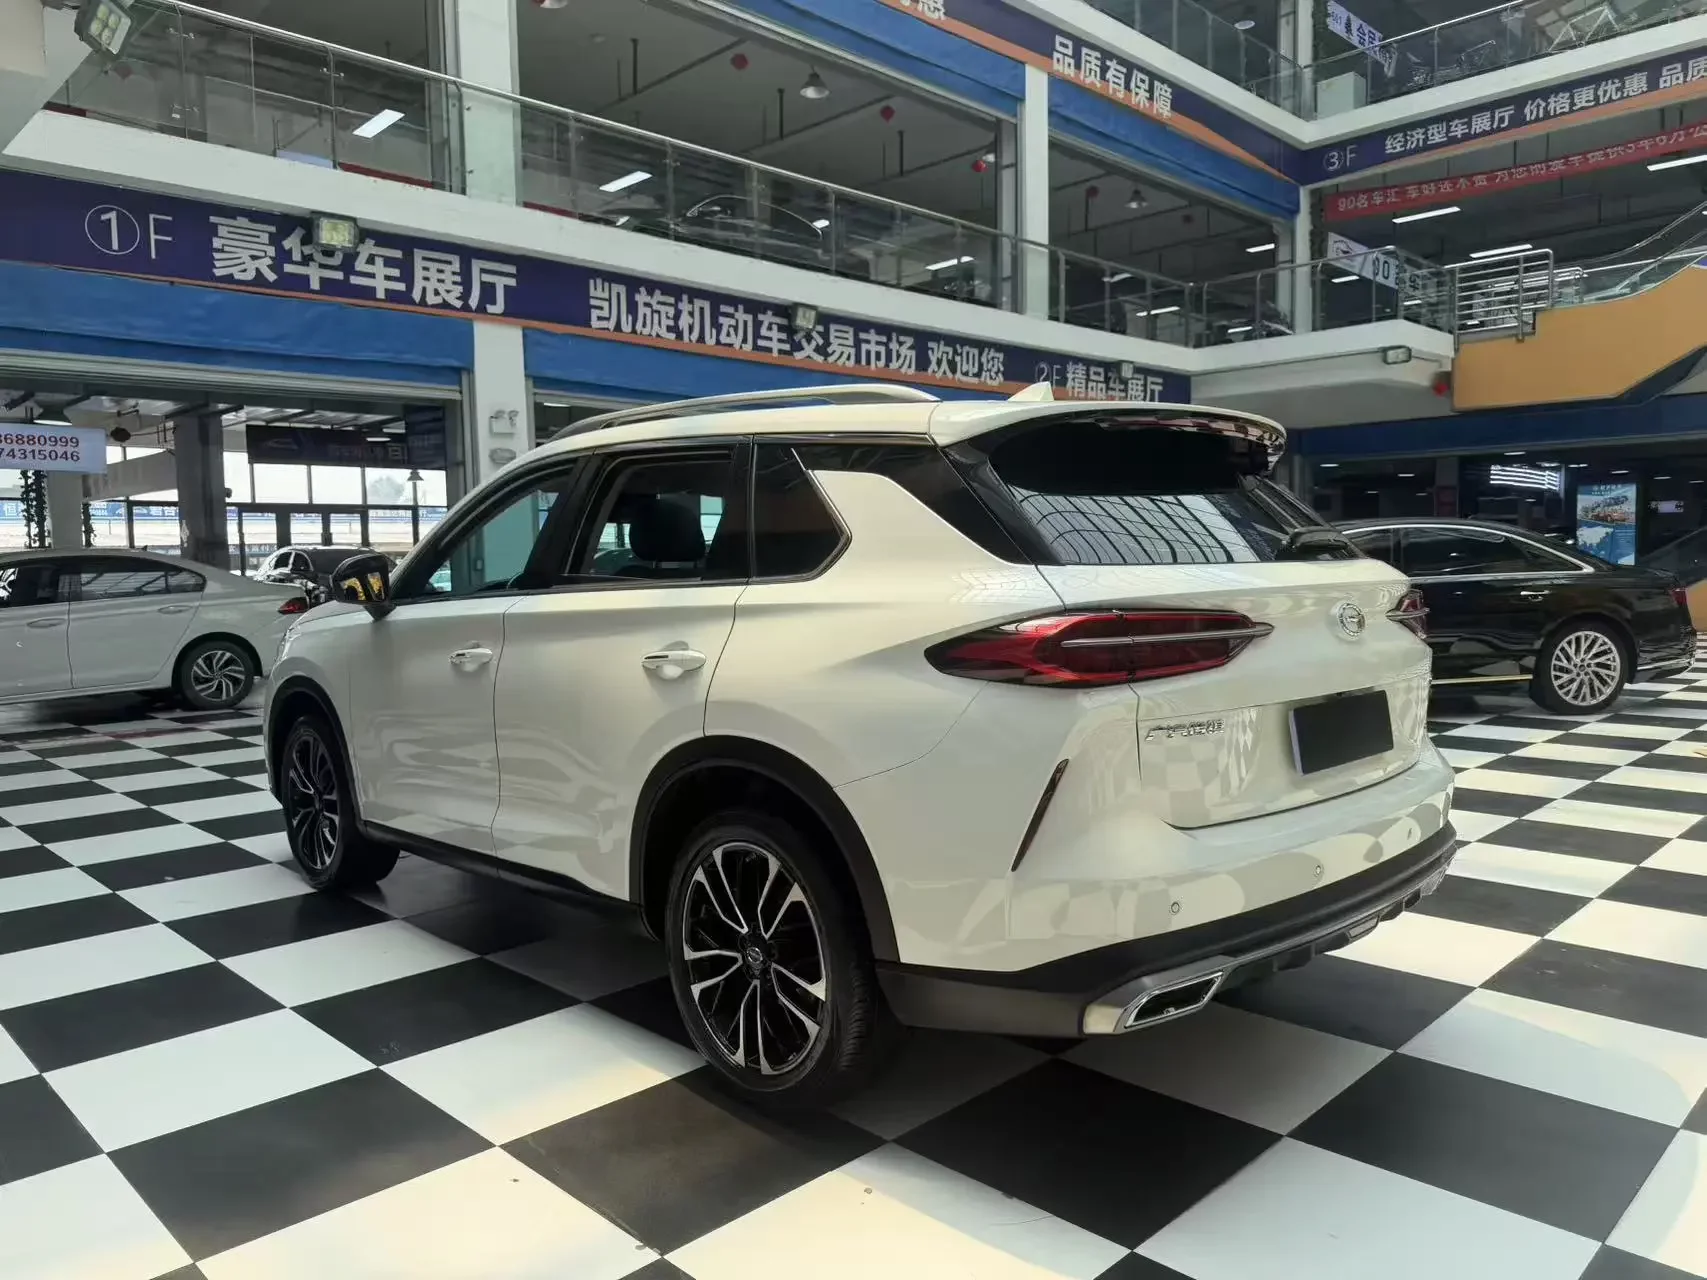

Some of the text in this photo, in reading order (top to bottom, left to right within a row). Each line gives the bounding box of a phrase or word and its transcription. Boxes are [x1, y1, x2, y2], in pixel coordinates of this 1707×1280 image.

[1052, 34, 1173, 119] 品质有保障
[1385, 104, 1515, 154] 经济型车展厅
[1523, 71, 1648, 122] 价格更优惠
[209, 215, 517, 315] 豪华车展厅
[589, 278, 1004, 387] 凯旋机动车交易市场 欢迎您
[1066, 360, 1163, 403] 精品车展厅
[0, 433, 80, 448] 6880999
